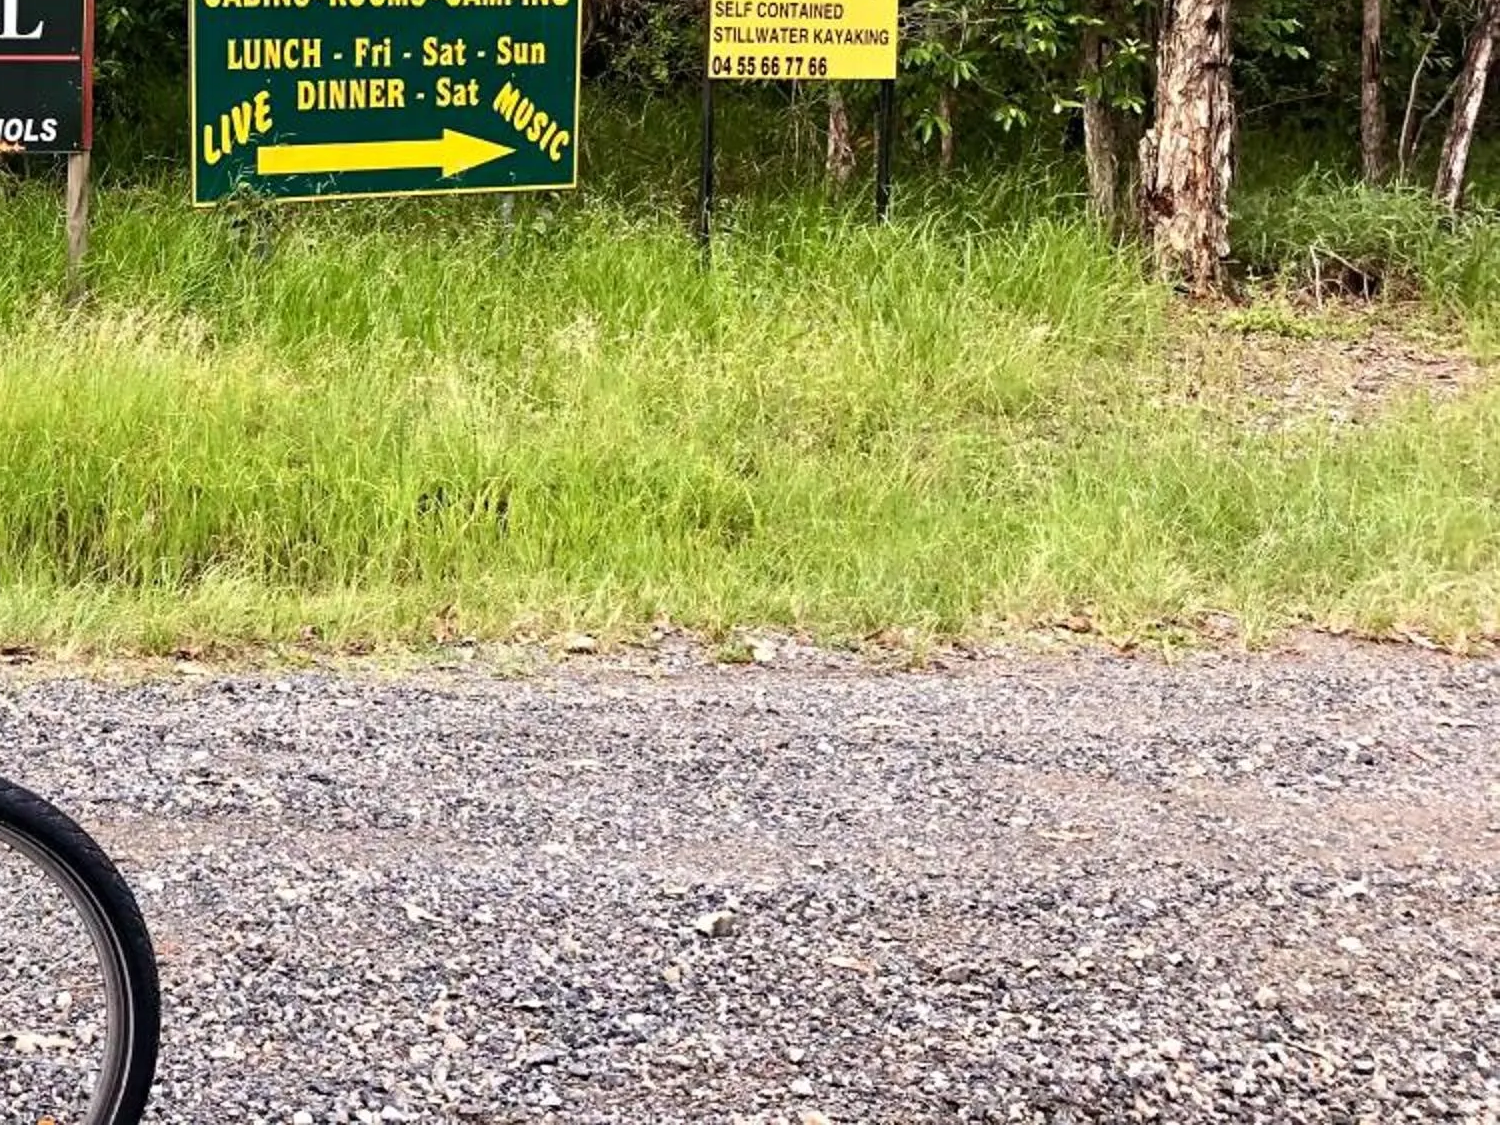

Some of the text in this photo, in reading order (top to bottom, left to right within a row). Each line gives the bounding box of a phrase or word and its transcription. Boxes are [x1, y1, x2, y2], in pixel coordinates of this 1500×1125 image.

[715, 0, 844, 19] SELF CONTAINED
[714, 26, 889, 45] STILLWATER KAYAKING
[227, 38, 322, 70] LUNCH
[355, 38, 392, 67] Fri
[422, 37, 467, 67] Sat
[496, 36, 546, 65] Sun
[712, 56, 827, 75] 04 55 66 77 66
[297, 78, 405, 111] DINNER
[435, 77, 480, 107] Sat
[203, 89, 274, 165] LIVE
[492, 81, 570, 163] MUSIC
